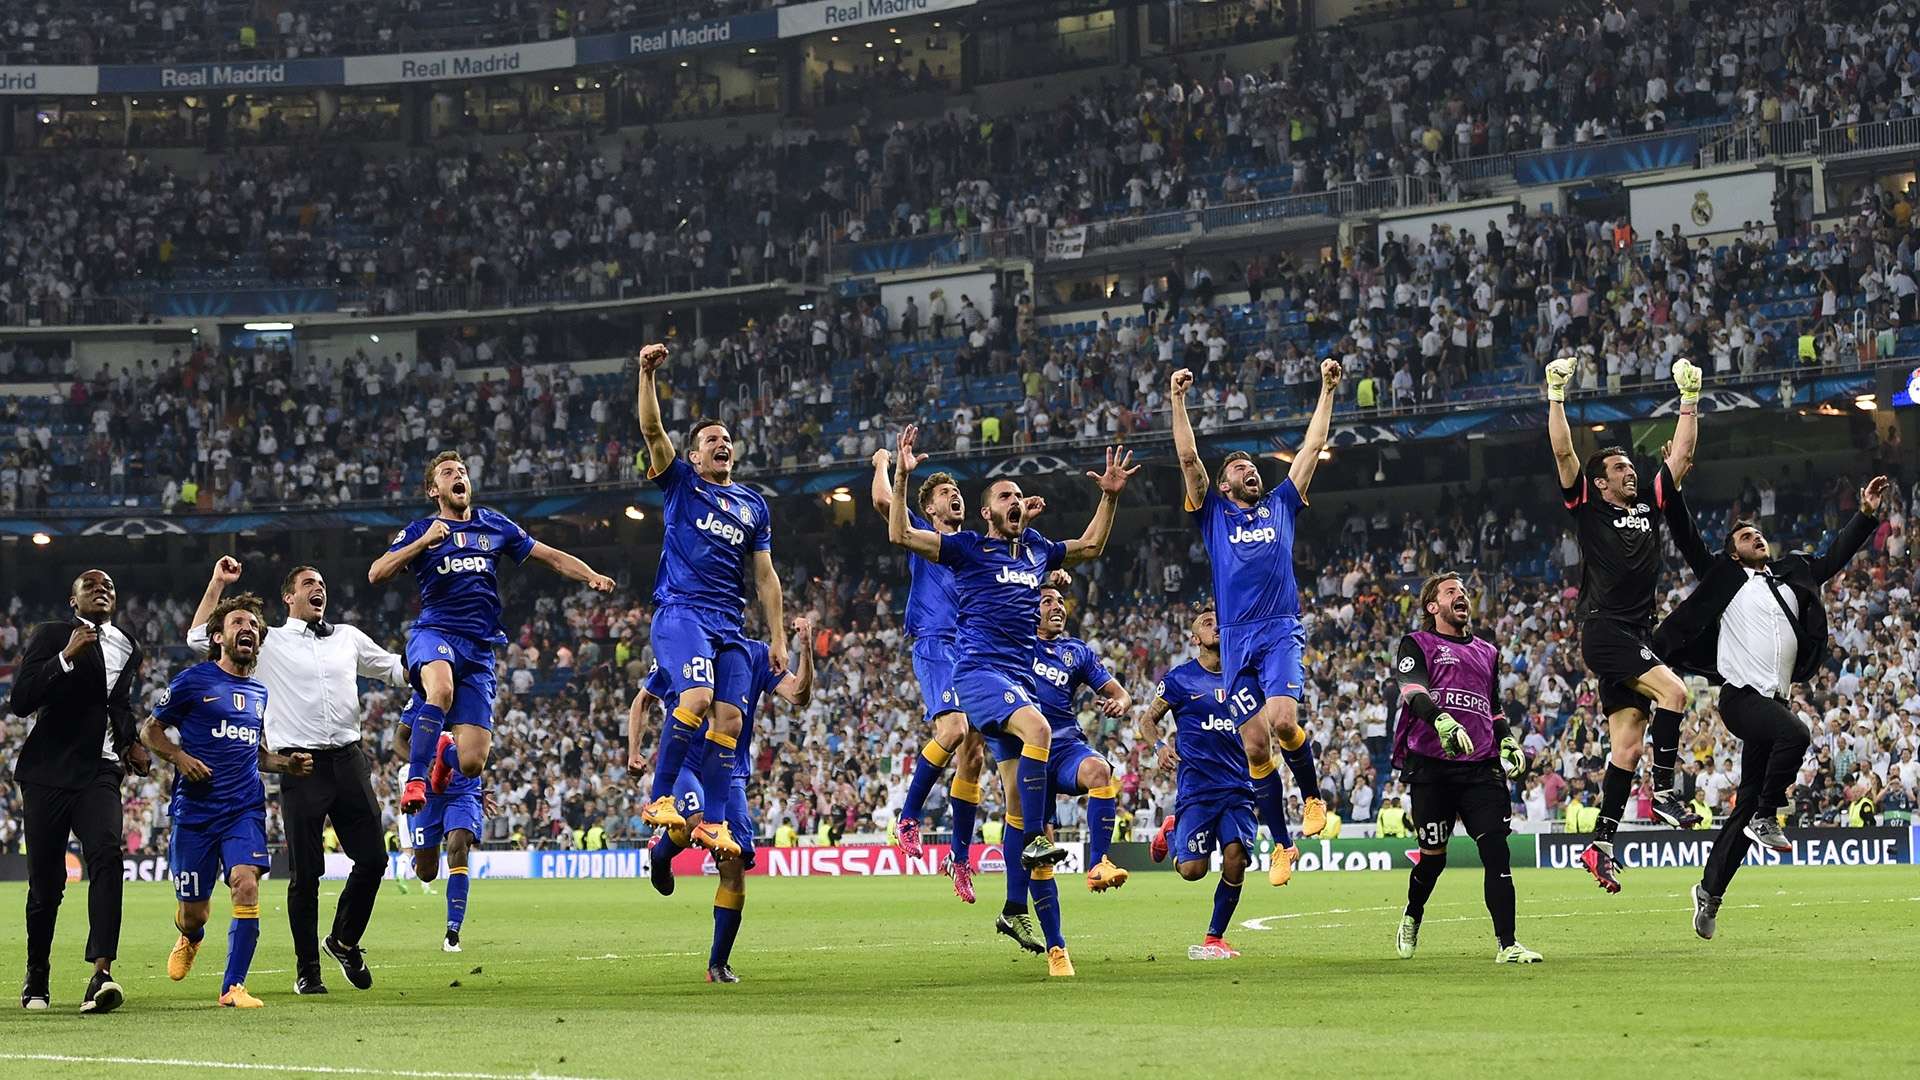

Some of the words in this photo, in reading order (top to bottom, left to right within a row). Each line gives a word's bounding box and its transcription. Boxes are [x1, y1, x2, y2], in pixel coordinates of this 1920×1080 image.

[825, 1, 862, 24] Real
[630, 34, 667, 54] Real
[671, 22, 731, 48] Madrid
[161, 67, 207, 88] Real
[212, 64, 285, 85] Madrid
[402, 59, 446, 79] Real
[453, 52, 520, 76] Madrid
[995, 566, 1039, 590] Jeep
[692, 656, 715, 685] 20
[1232, 686, 1257, 716] 15
[1445, 692, 1490, 714] RESPEC
[684, 791, 700, 812] 3
[415, 827, 425, 846] 6
[1426, 821, 1448, 845] 30
[767, 848, 938, 877] NISSAN
[1623, 841, 1782, 868] CHAMPNS
[1792, 838, 1897, 866] LEAGUE
[180, 871, 199, 897] 21
